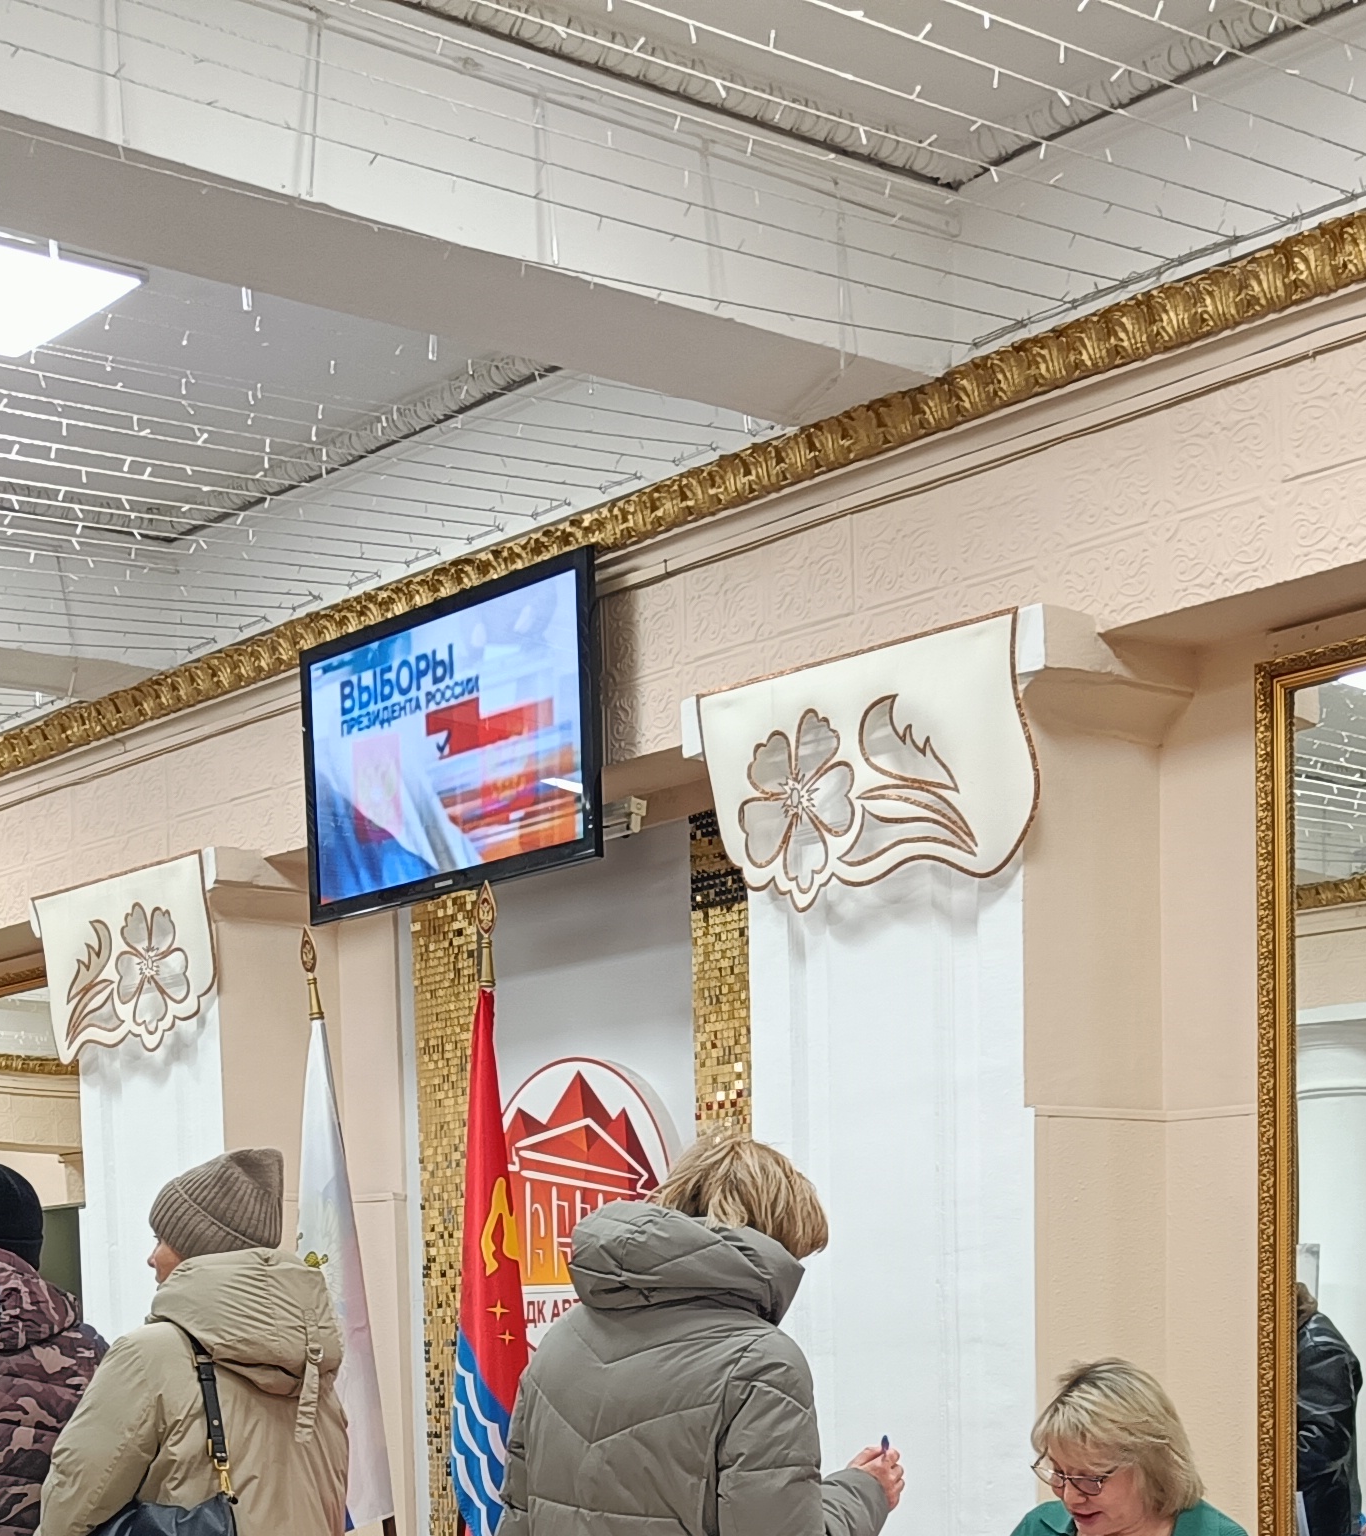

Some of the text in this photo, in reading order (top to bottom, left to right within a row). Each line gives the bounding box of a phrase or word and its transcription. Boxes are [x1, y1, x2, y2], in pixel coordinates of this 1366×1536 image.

[340, 643, 455, 717] ВЫБОРЫ
[341, 674, 480, 738] ПРЕЗИДЕНТА РОССИИ
[525, 1300, 546, 1328] ДК
